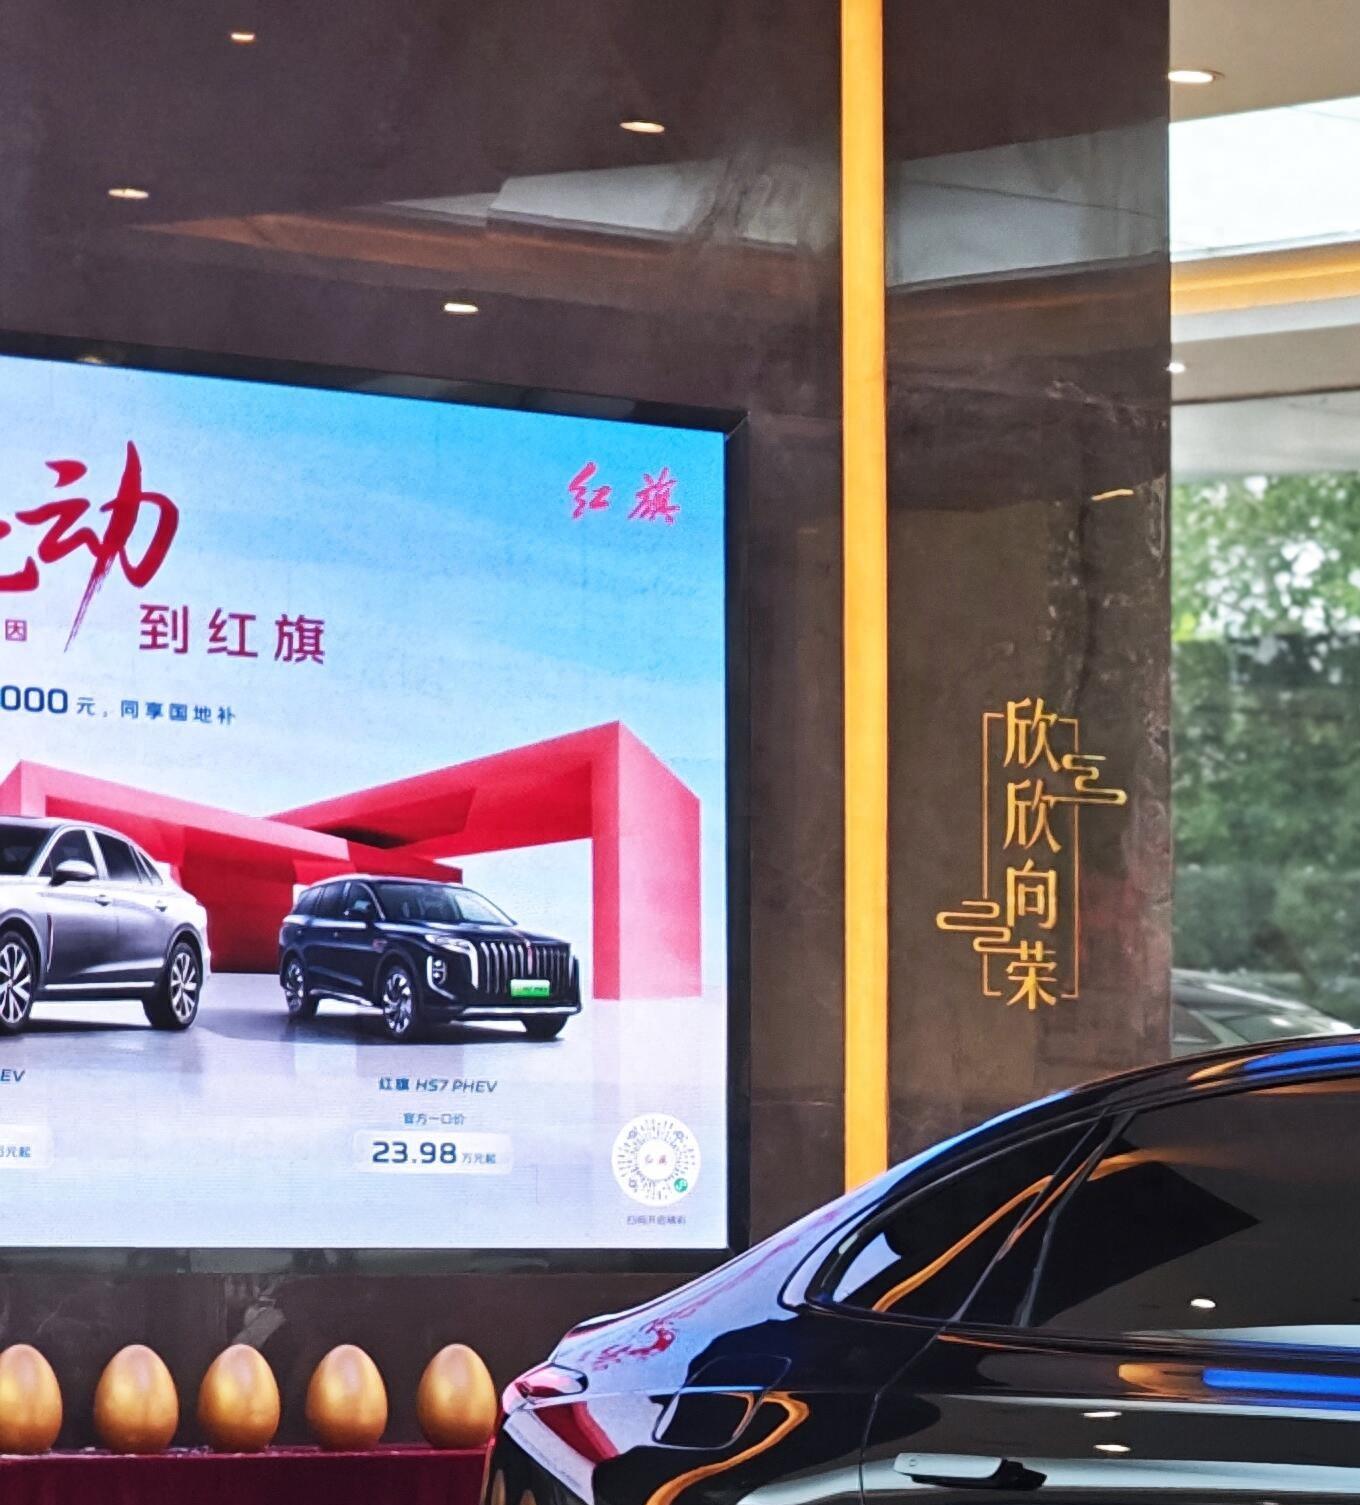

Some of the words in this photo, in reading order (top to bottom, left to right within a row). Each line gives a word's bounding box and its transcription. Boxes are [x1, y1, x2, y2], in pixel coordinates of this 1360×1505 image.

[568, 462, 681, 526] 红旗
[139, 604, 326, 664] 到红旗
[1003, 697, 1062, 1010] 欣欣向荣
[415, 1078, 449, 1092] HS7
[452, 1079, 498, 1093] PHEV
